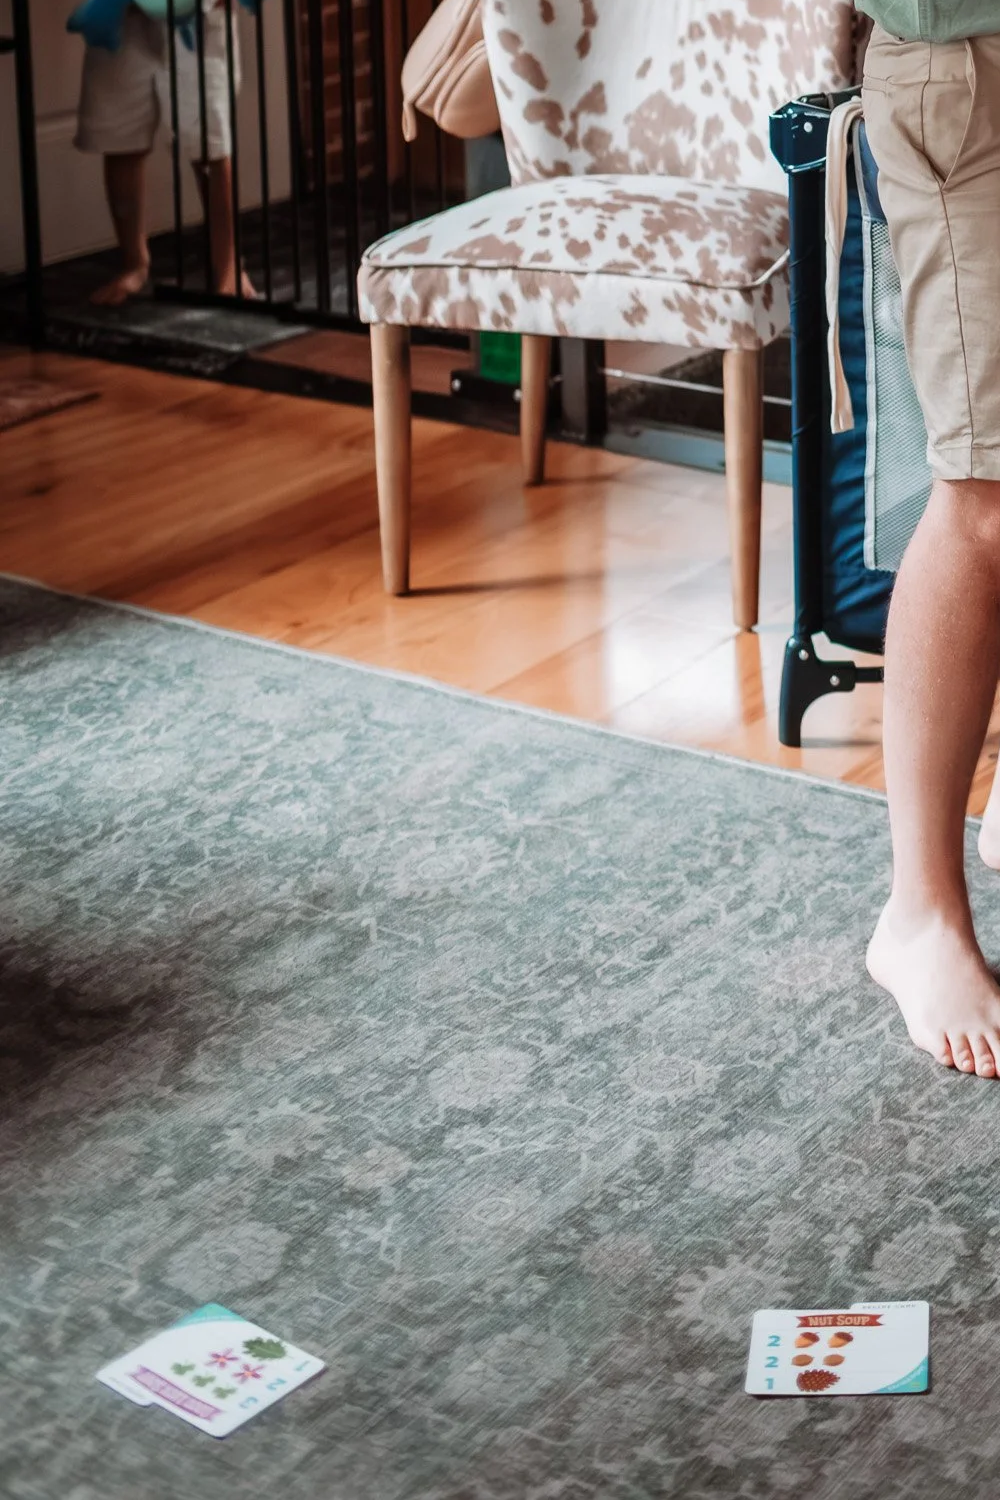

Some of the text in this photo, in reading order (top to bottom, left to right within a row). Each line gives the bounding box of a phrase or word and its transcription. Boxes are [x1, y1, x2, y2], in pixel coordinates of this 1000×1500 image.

[808, 1314, 870, 1327] NUT SOUP
[767, 1334, 781, 1347] 2
[764, 1355, 779, 1368] 2
[764, 1377, 774, 1390] 1
